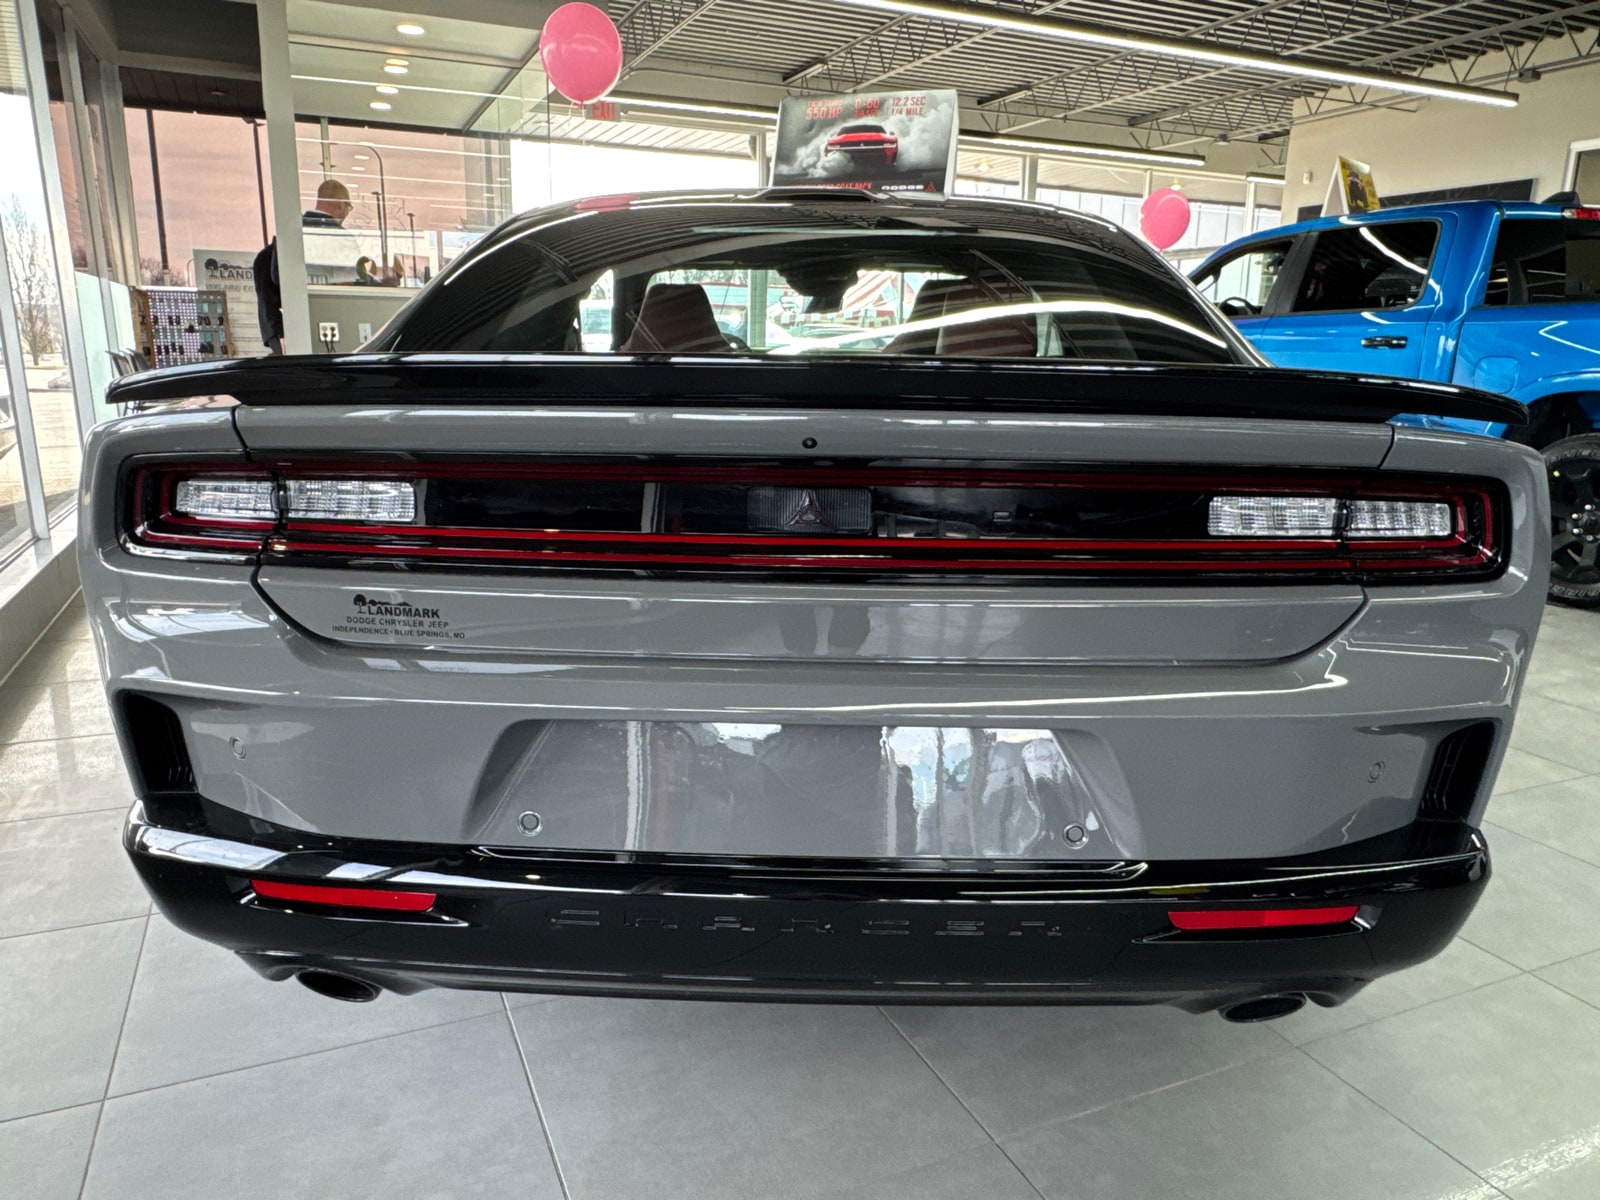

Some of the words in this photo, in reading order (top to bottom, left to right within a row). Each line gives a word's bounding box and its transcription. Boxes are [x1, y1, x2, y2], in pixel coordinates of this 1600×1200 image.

[892, 96, 909, 107] 12.2
[911, 96, 927, 106] SEC
[805, 106, 827, 120] 550
[829, 106, 843, 119] HP
[219, 269, 253, 280] LAND
[367, 605, 440, 619] LANDMARK
[346, 616, 377, 625] DODGE
[378, 618, 425, 628] CHRYSLER
[427, 621, 449, 629] JEEP
[453, 632, 466, 640] MO
[545, 908, 1063, 937] CHARGER
